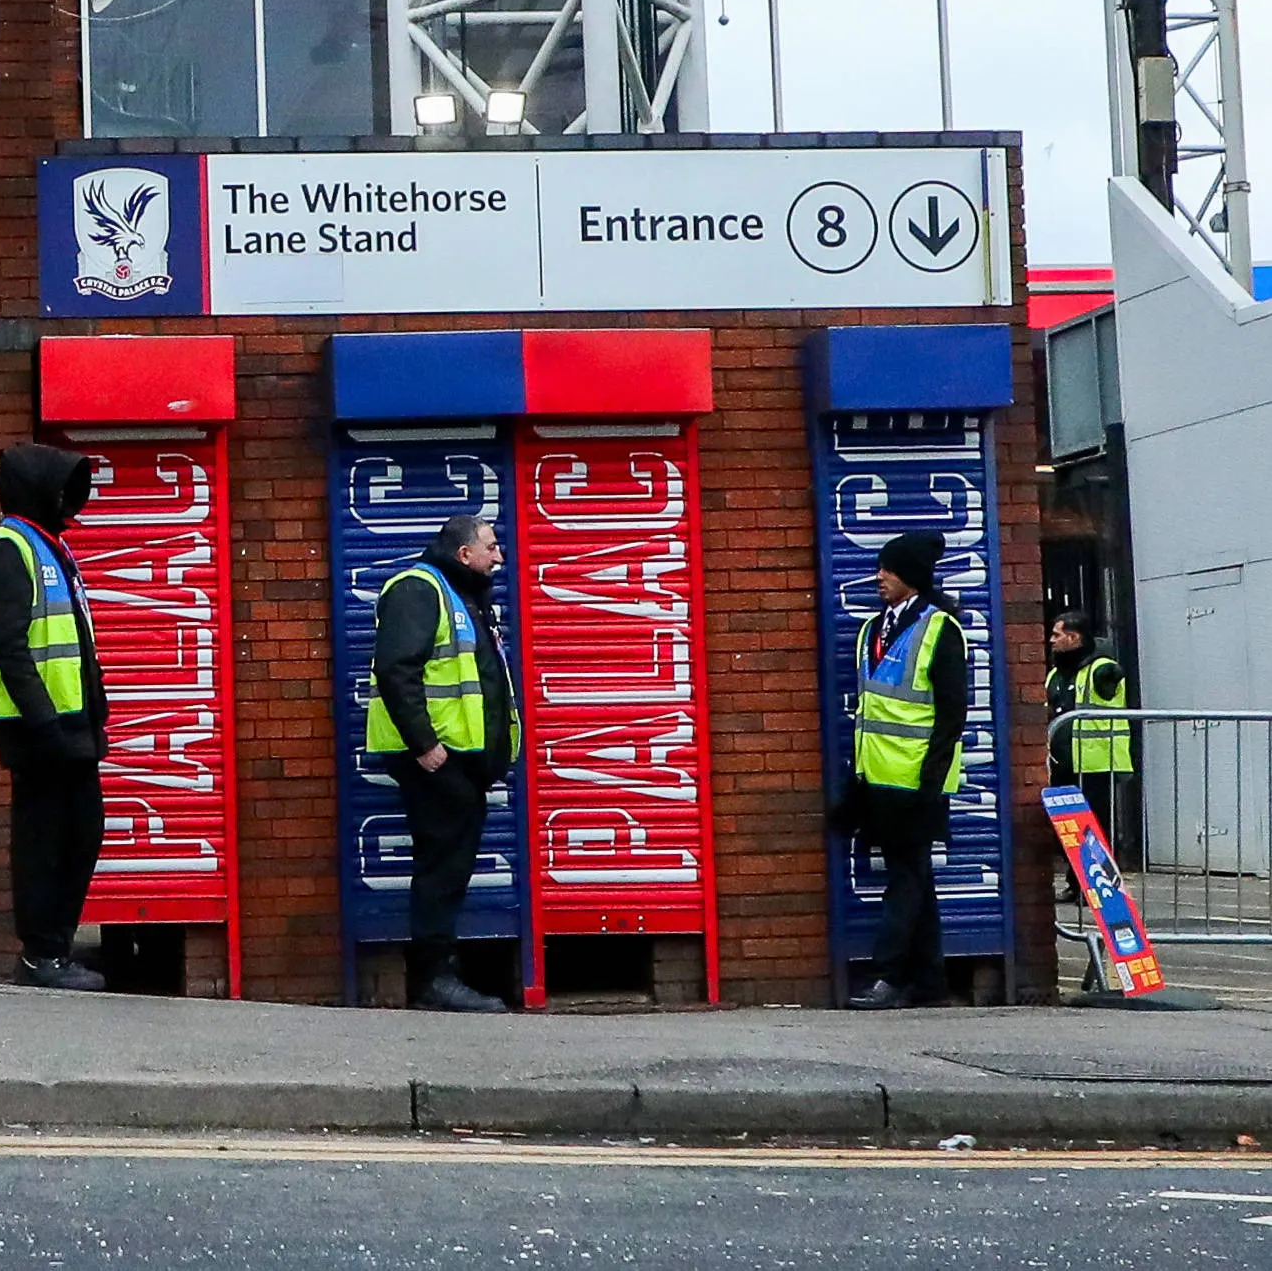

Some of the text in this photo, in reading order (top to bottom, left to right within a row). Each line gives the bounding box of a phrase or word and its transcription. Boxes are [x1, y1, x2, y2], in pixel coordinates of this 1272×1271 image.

[222, 181, 507, 214] The Whitehorse
[225, 222, 417, 254] Lane Stand
[580, 206, 847, 247] Entrance 8
[81, 277, 165, 297] CRYSTAL PALACE F.C.
